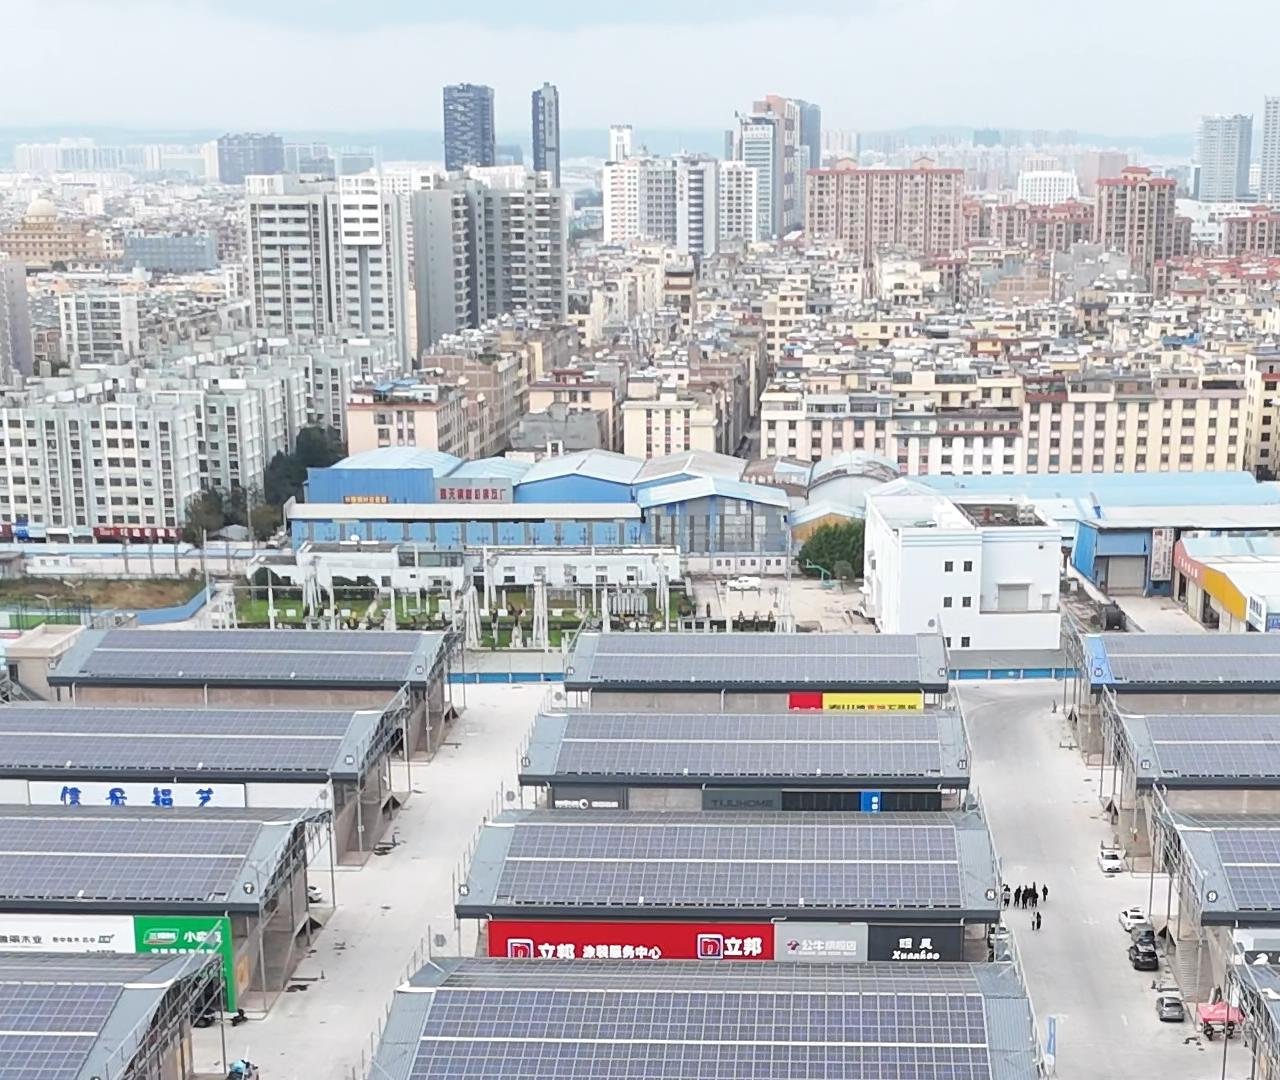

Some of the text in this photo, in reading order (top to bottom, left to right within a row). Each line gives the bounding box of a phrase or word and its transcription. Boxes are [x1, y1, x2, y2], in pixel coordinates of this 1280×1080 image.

[538, 943, 576, 959] 立邦
[583, 944, 662, 959] 涂装服务中心
[724, 936, 763, 956] 立邦
